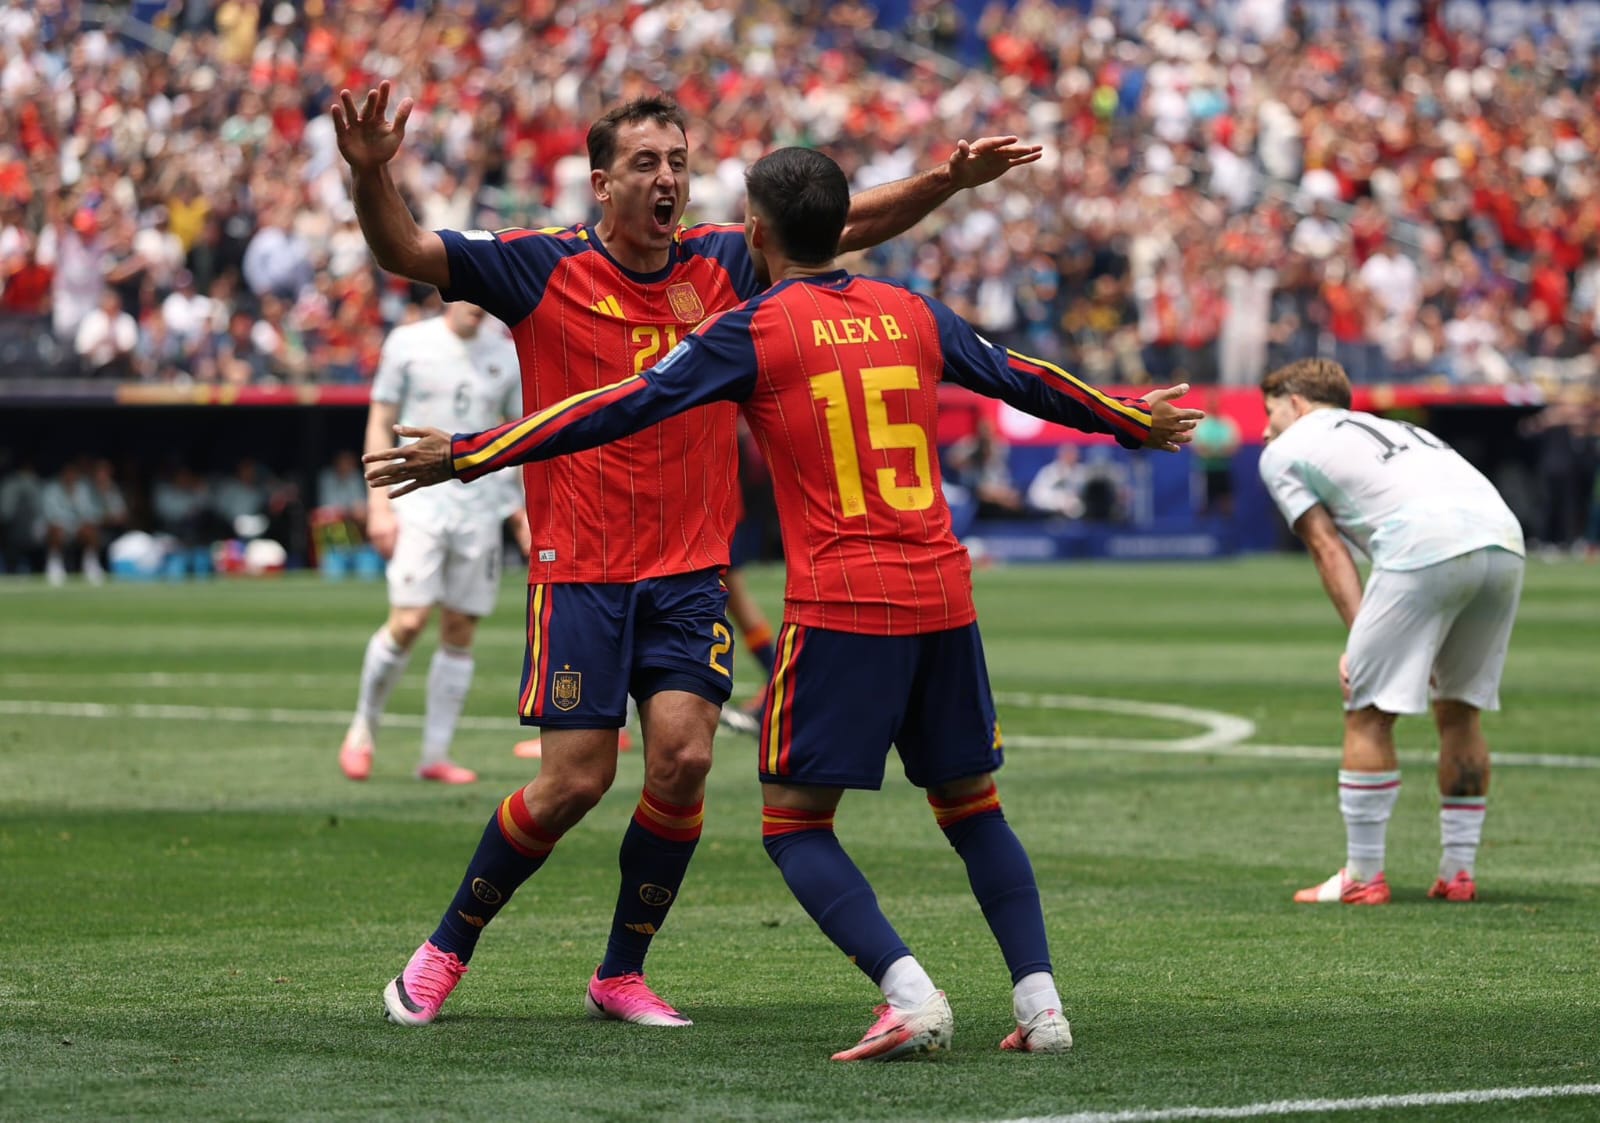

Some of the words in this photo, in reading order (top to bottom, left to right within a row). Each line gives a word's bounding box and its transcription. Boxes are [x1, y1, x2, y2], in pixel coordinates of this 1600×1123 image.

[811, 317, 879, 346] ALEX
[879, 314, 908, 341] B.
[453, 380, 471, 416] 6
[809, 365, 935, 518] 15
[709, 622, 731, 678] 2
